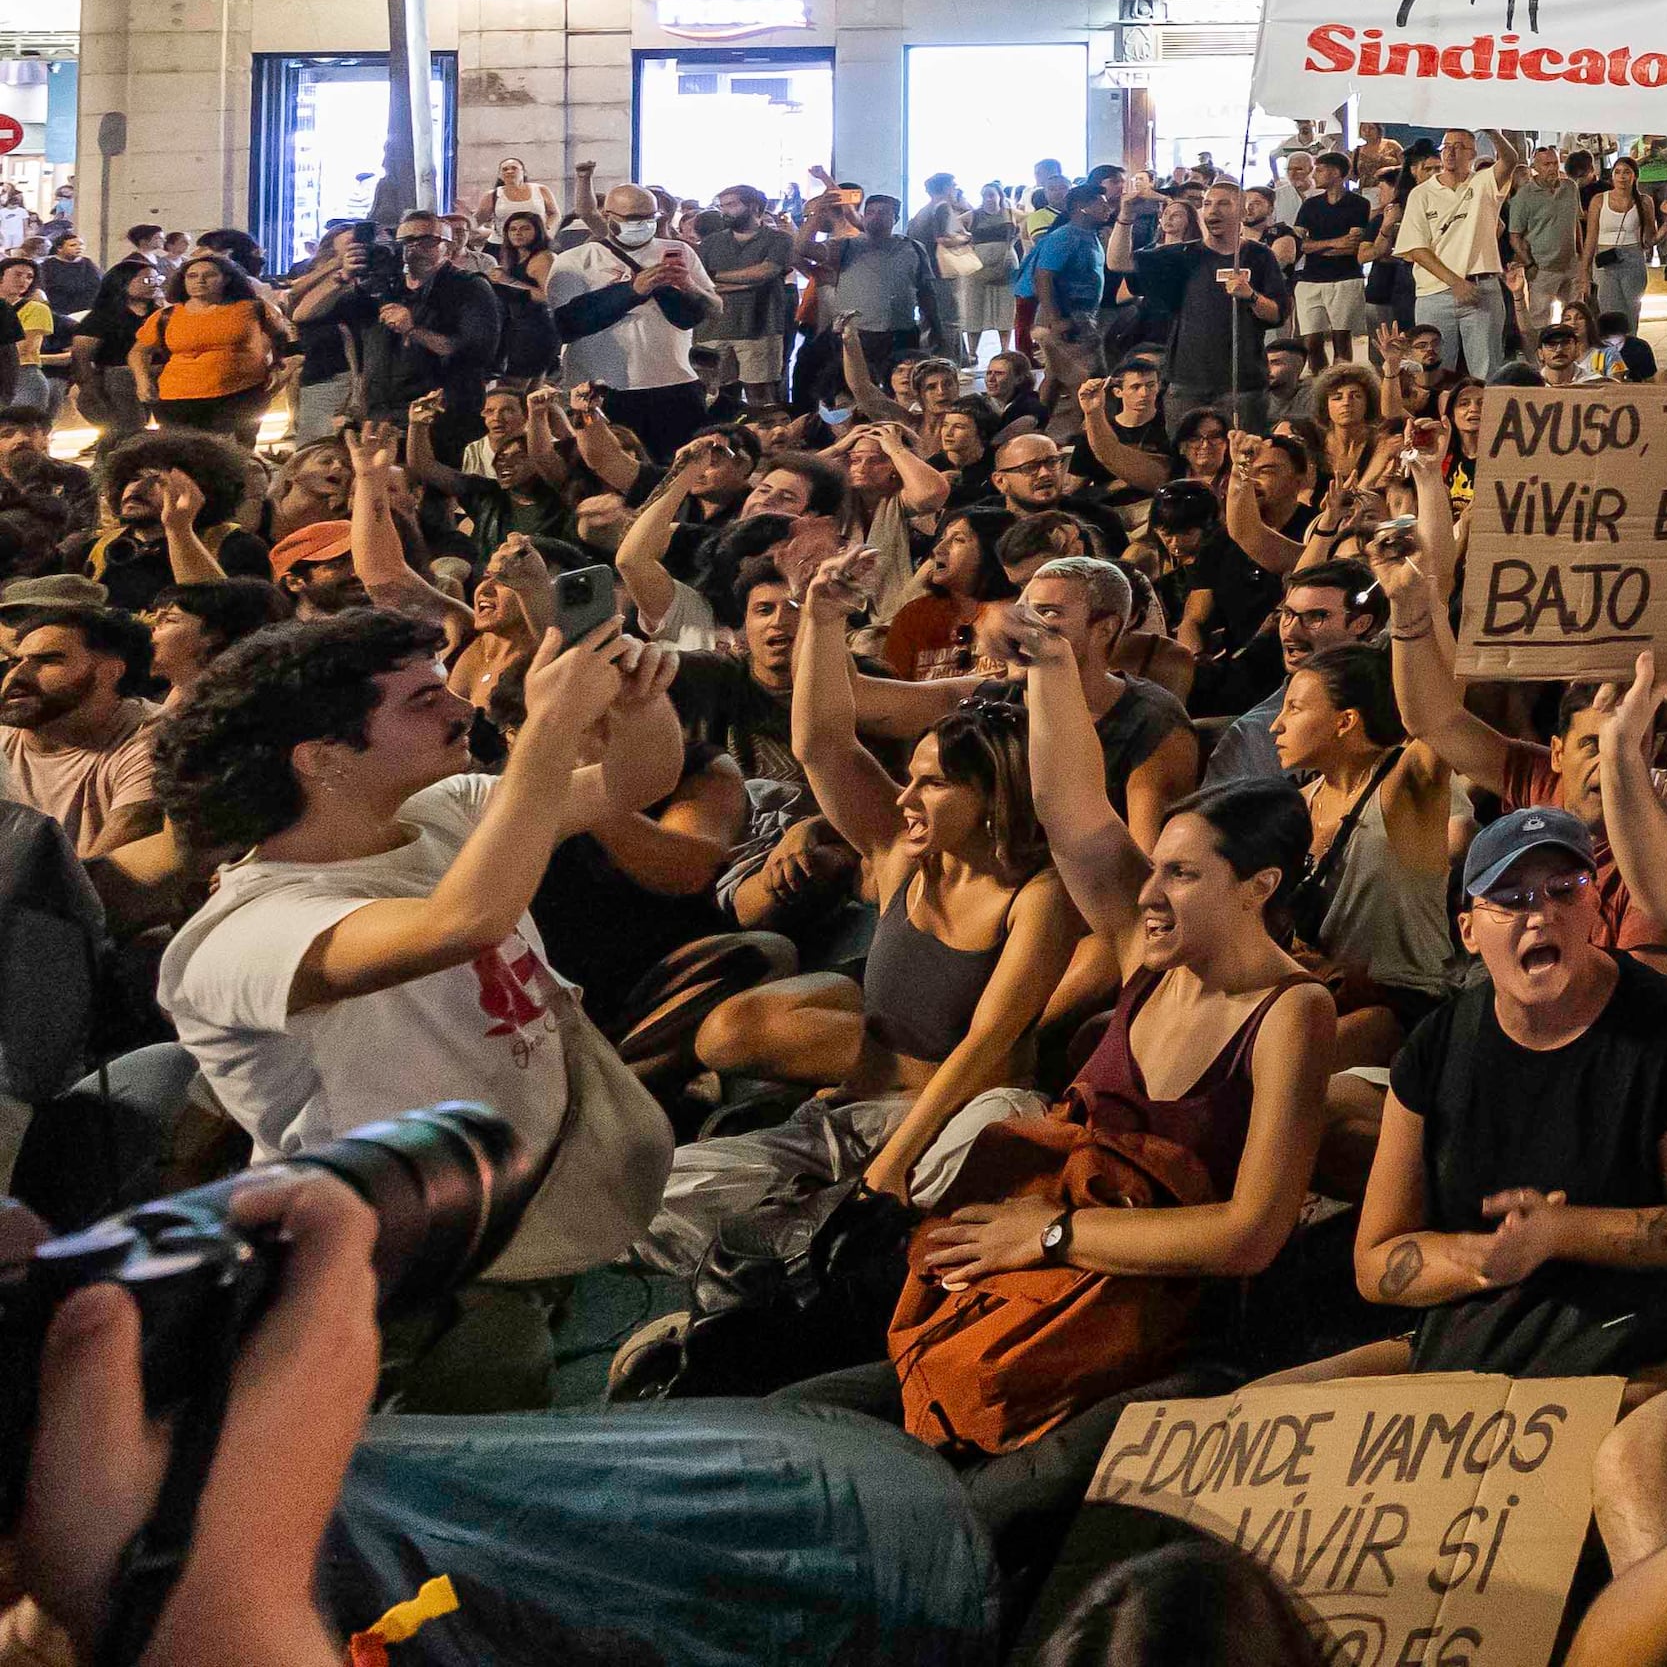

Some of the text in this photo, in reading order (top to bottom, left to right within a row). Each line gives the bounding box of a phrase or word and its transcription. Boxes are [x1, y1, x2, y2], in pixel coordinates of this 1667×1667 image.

[1489, 397, 1649, 459] AYUSO,
[1483, 559, 1651, 636] BAJO
[1098, 1404, 1569, 1500] ¿DÓNDE VAMOS
